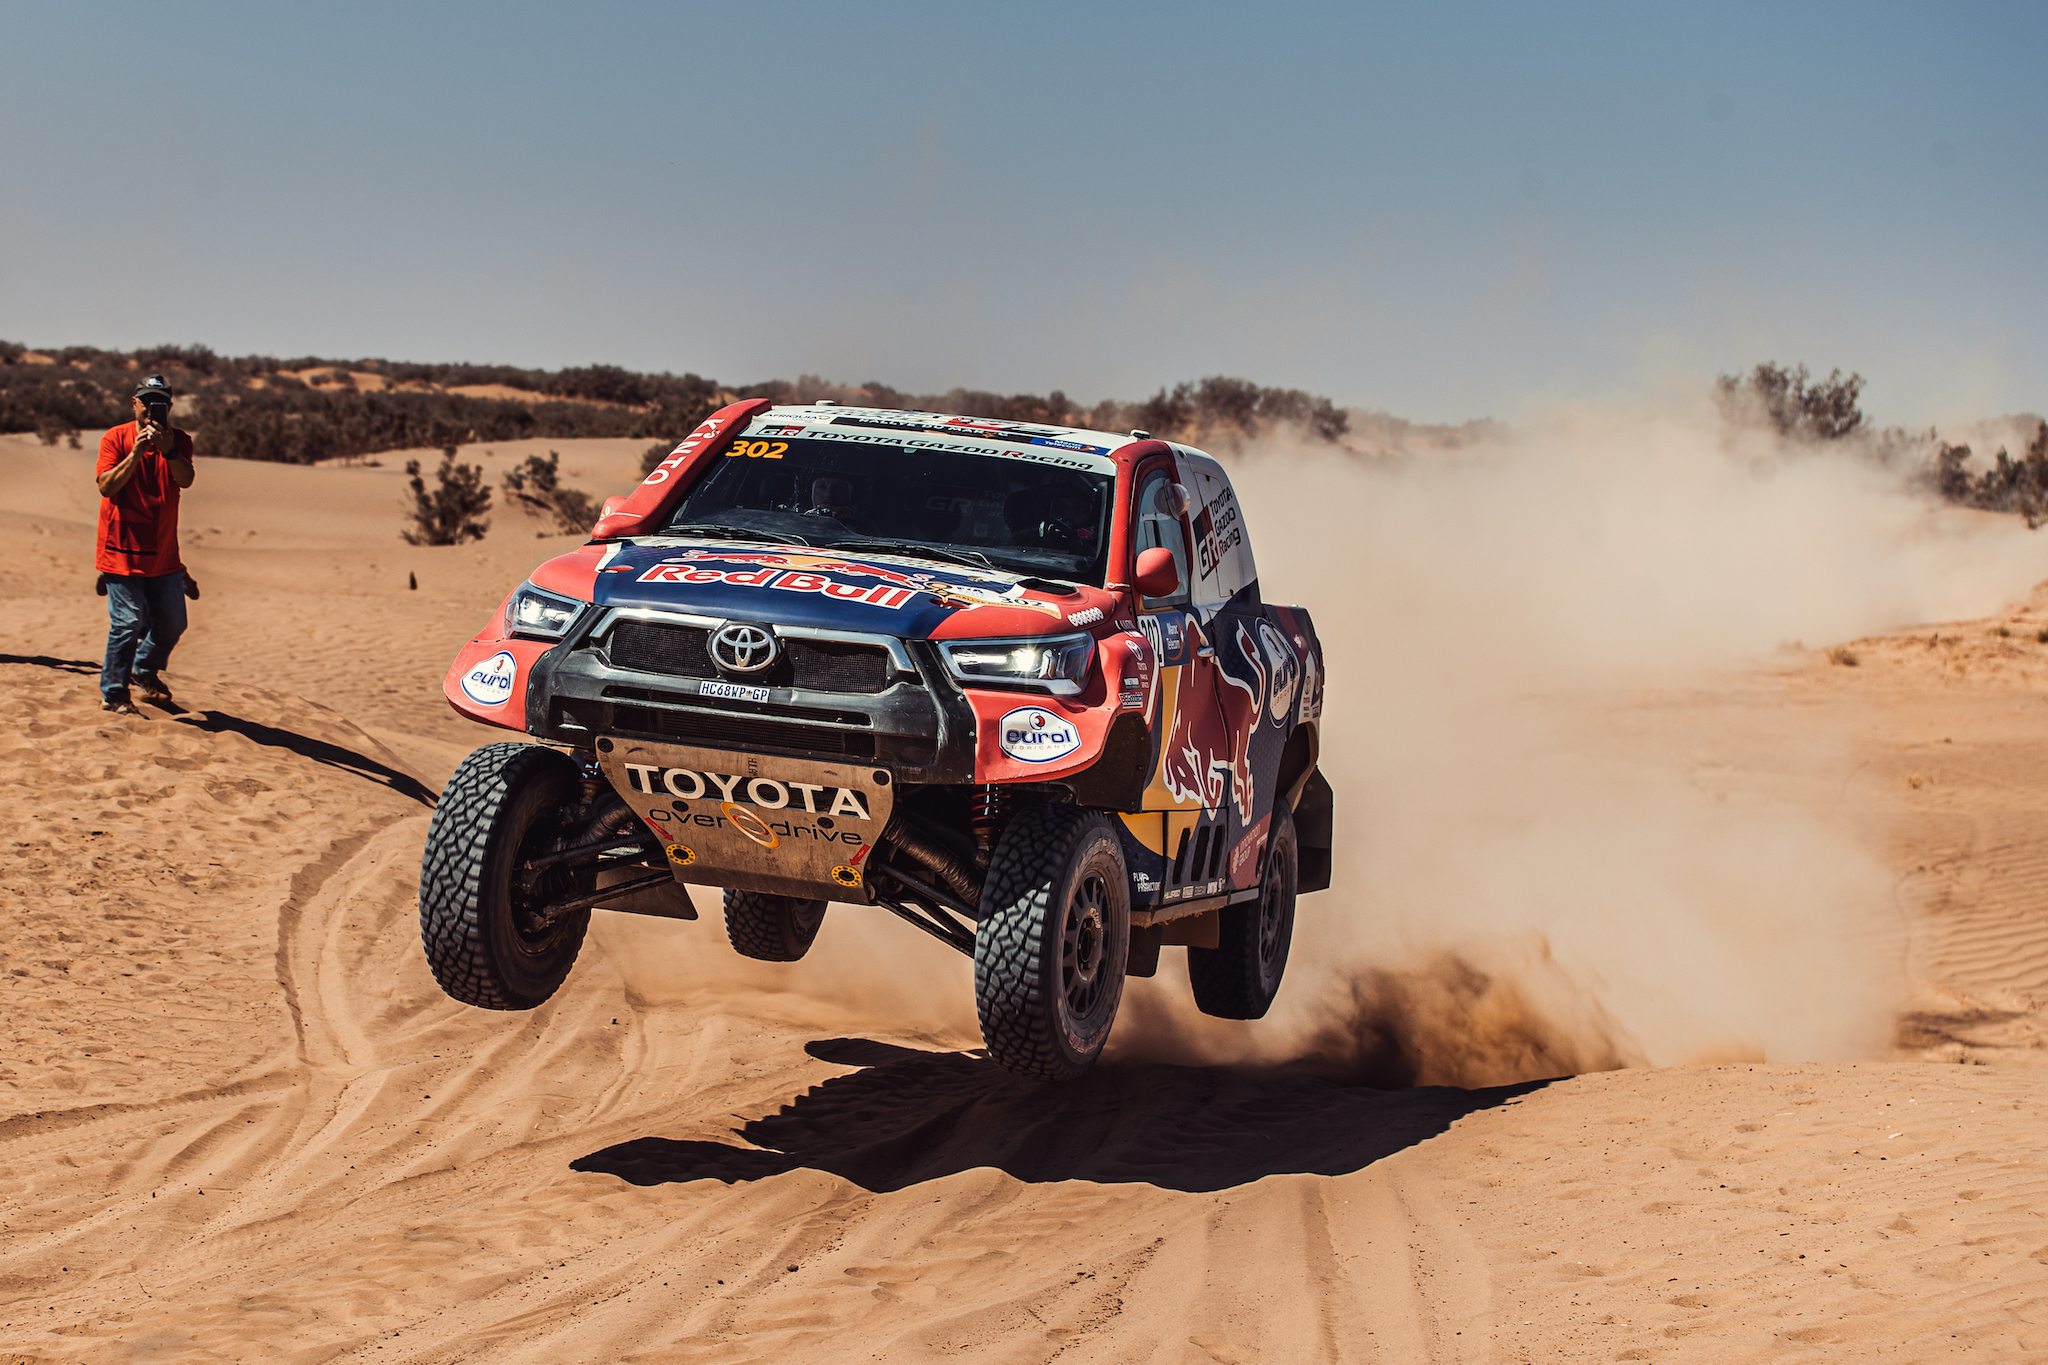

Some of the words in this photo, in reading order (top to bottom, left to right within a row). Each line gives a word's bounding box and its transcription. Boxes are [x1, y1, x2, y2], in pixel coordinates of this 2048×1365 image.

[757, 426, 803, 437] GR
[642, 418, 725, 485] KINTO
[725, 440, 789, 459] 302
[807, 430, 902, 445] TOYOTA
[906, 439, 999, 456] GAZOO
[1001, 450, 1094, 471] Racing
[1209, 486, 1233, 518] TOYOTA
[1214, 507, 1236, 537] GAZOO
[1218, 527, 1241, 557] Racing
[637, 564, 780, 586] Red
[772, 573, 916, 608] Bull
[999, 595, 1045, 608] 302
[471, 671, 511, 690] eurol
[701, 682, 746, 698] HC68WP
[752, 688, 768, 700] GP
[1006, 729, 1071, 744] eurol
[624, 763, 871, 821] TOYOTA
[649, 808, 728, 829] over
[769, 820, 863, 846] drive
